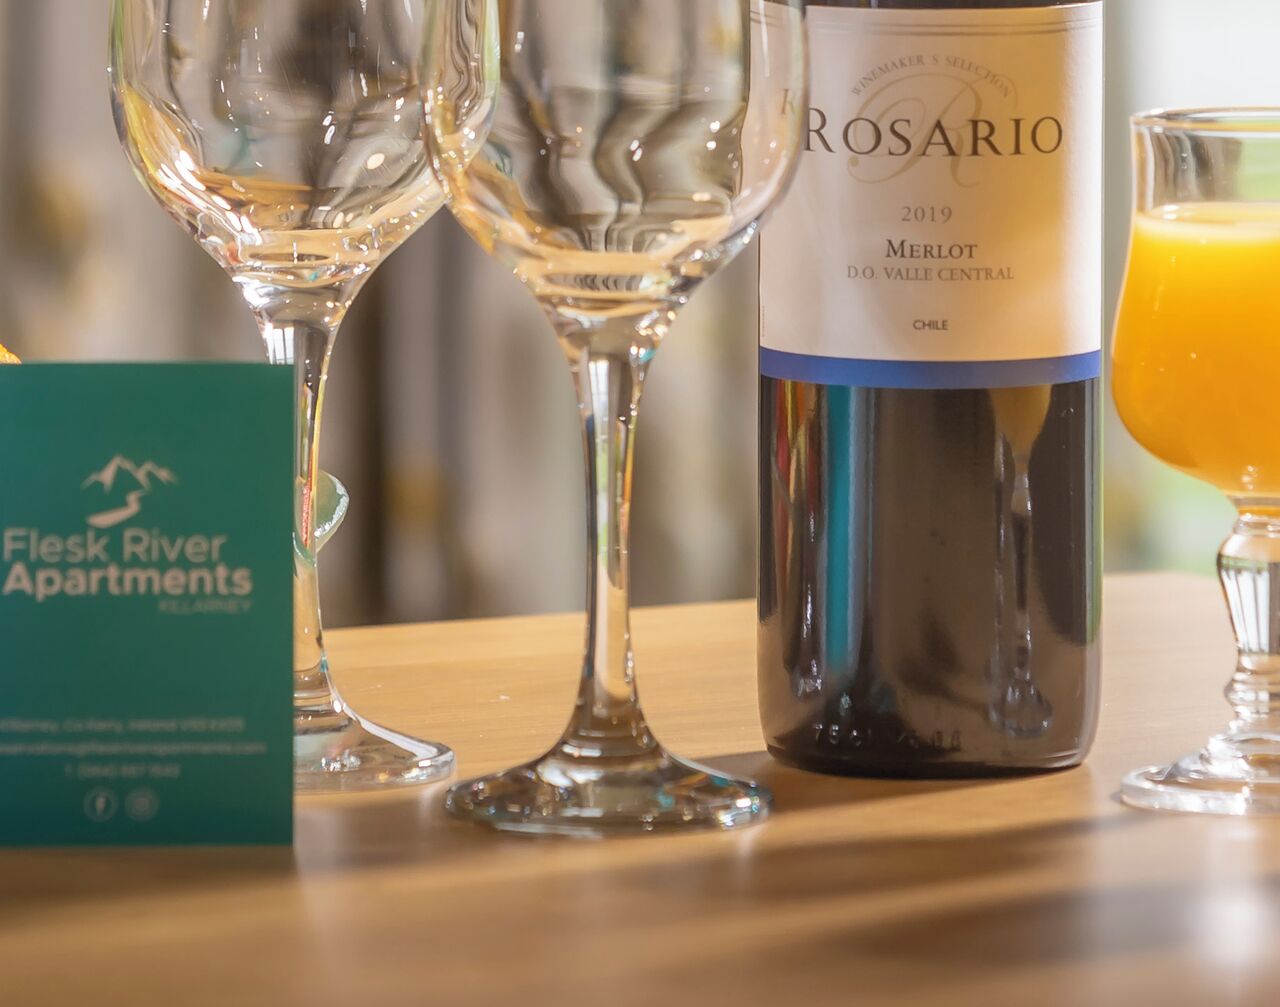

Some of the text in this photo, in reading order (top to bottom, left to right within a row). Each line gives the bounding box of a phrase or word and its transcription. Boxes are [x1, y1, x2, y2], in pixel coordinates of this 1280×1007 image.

[945, 56, 1011, 98] SELECTION
[803, 107, 1063, 157] ROSARIO
[901, 206, 953, 223] 2019
[847, 265, 1014, 281] D.O. VALLE CENTRAL
[913, 319, 948, 331] CHILE
[3, 528, 227, 563] Flesk River
[2, 563, 253, 602] Apartments
